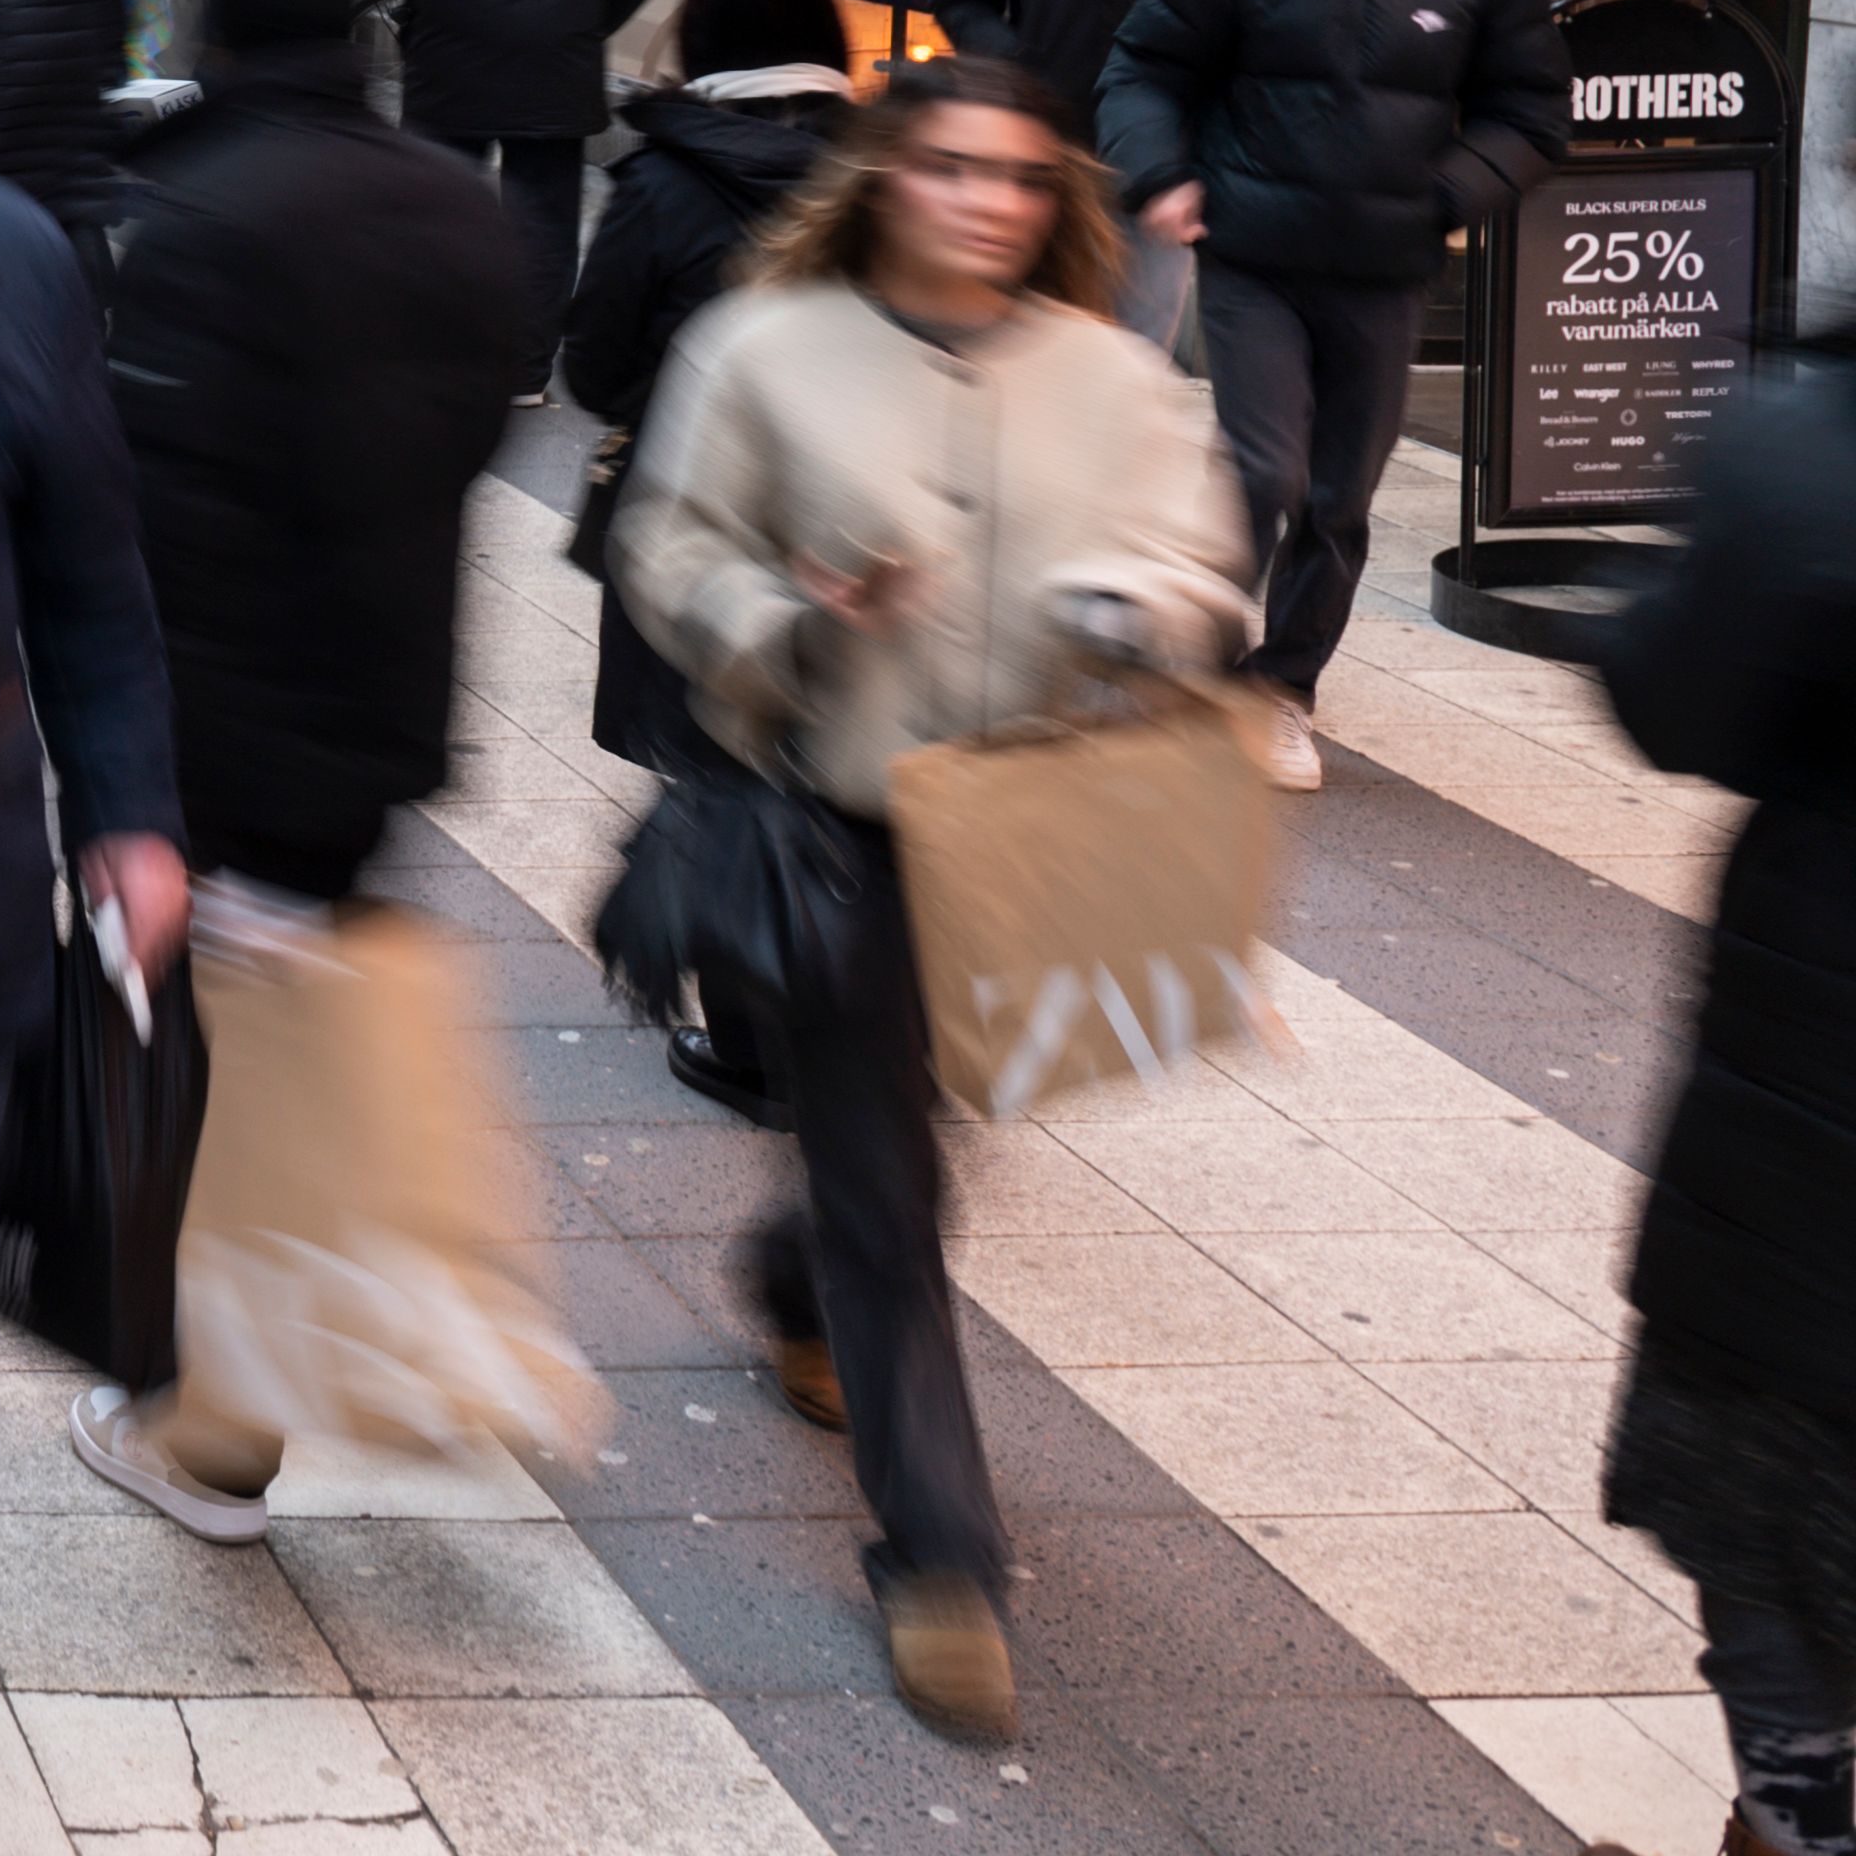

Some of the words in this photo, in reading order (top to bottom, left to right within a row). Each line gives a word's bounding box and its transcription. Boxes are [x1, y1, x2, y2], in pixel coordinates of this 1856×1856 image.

[1571, 71, 1745, 122] ROTHERS
[1565, 202, 1612, 216] BLACK
[1613, 200, 1659, 214] SUPER
[1661, 198, 1707, 212] DEALS
[1562, 230, 1705, 284] 25%
[1546, 294, 1617, 316] rabatt
[1621, 292, 1650, 319] på
[1653, 290, 1719, 313] ALLA
[1561, 317, 1701, 341] varumärken
[1583, 363, 1604, 373] EAST
[1605, 362, 1627, 372] WEST
[1611, 435, 1646, 447] HUGO
